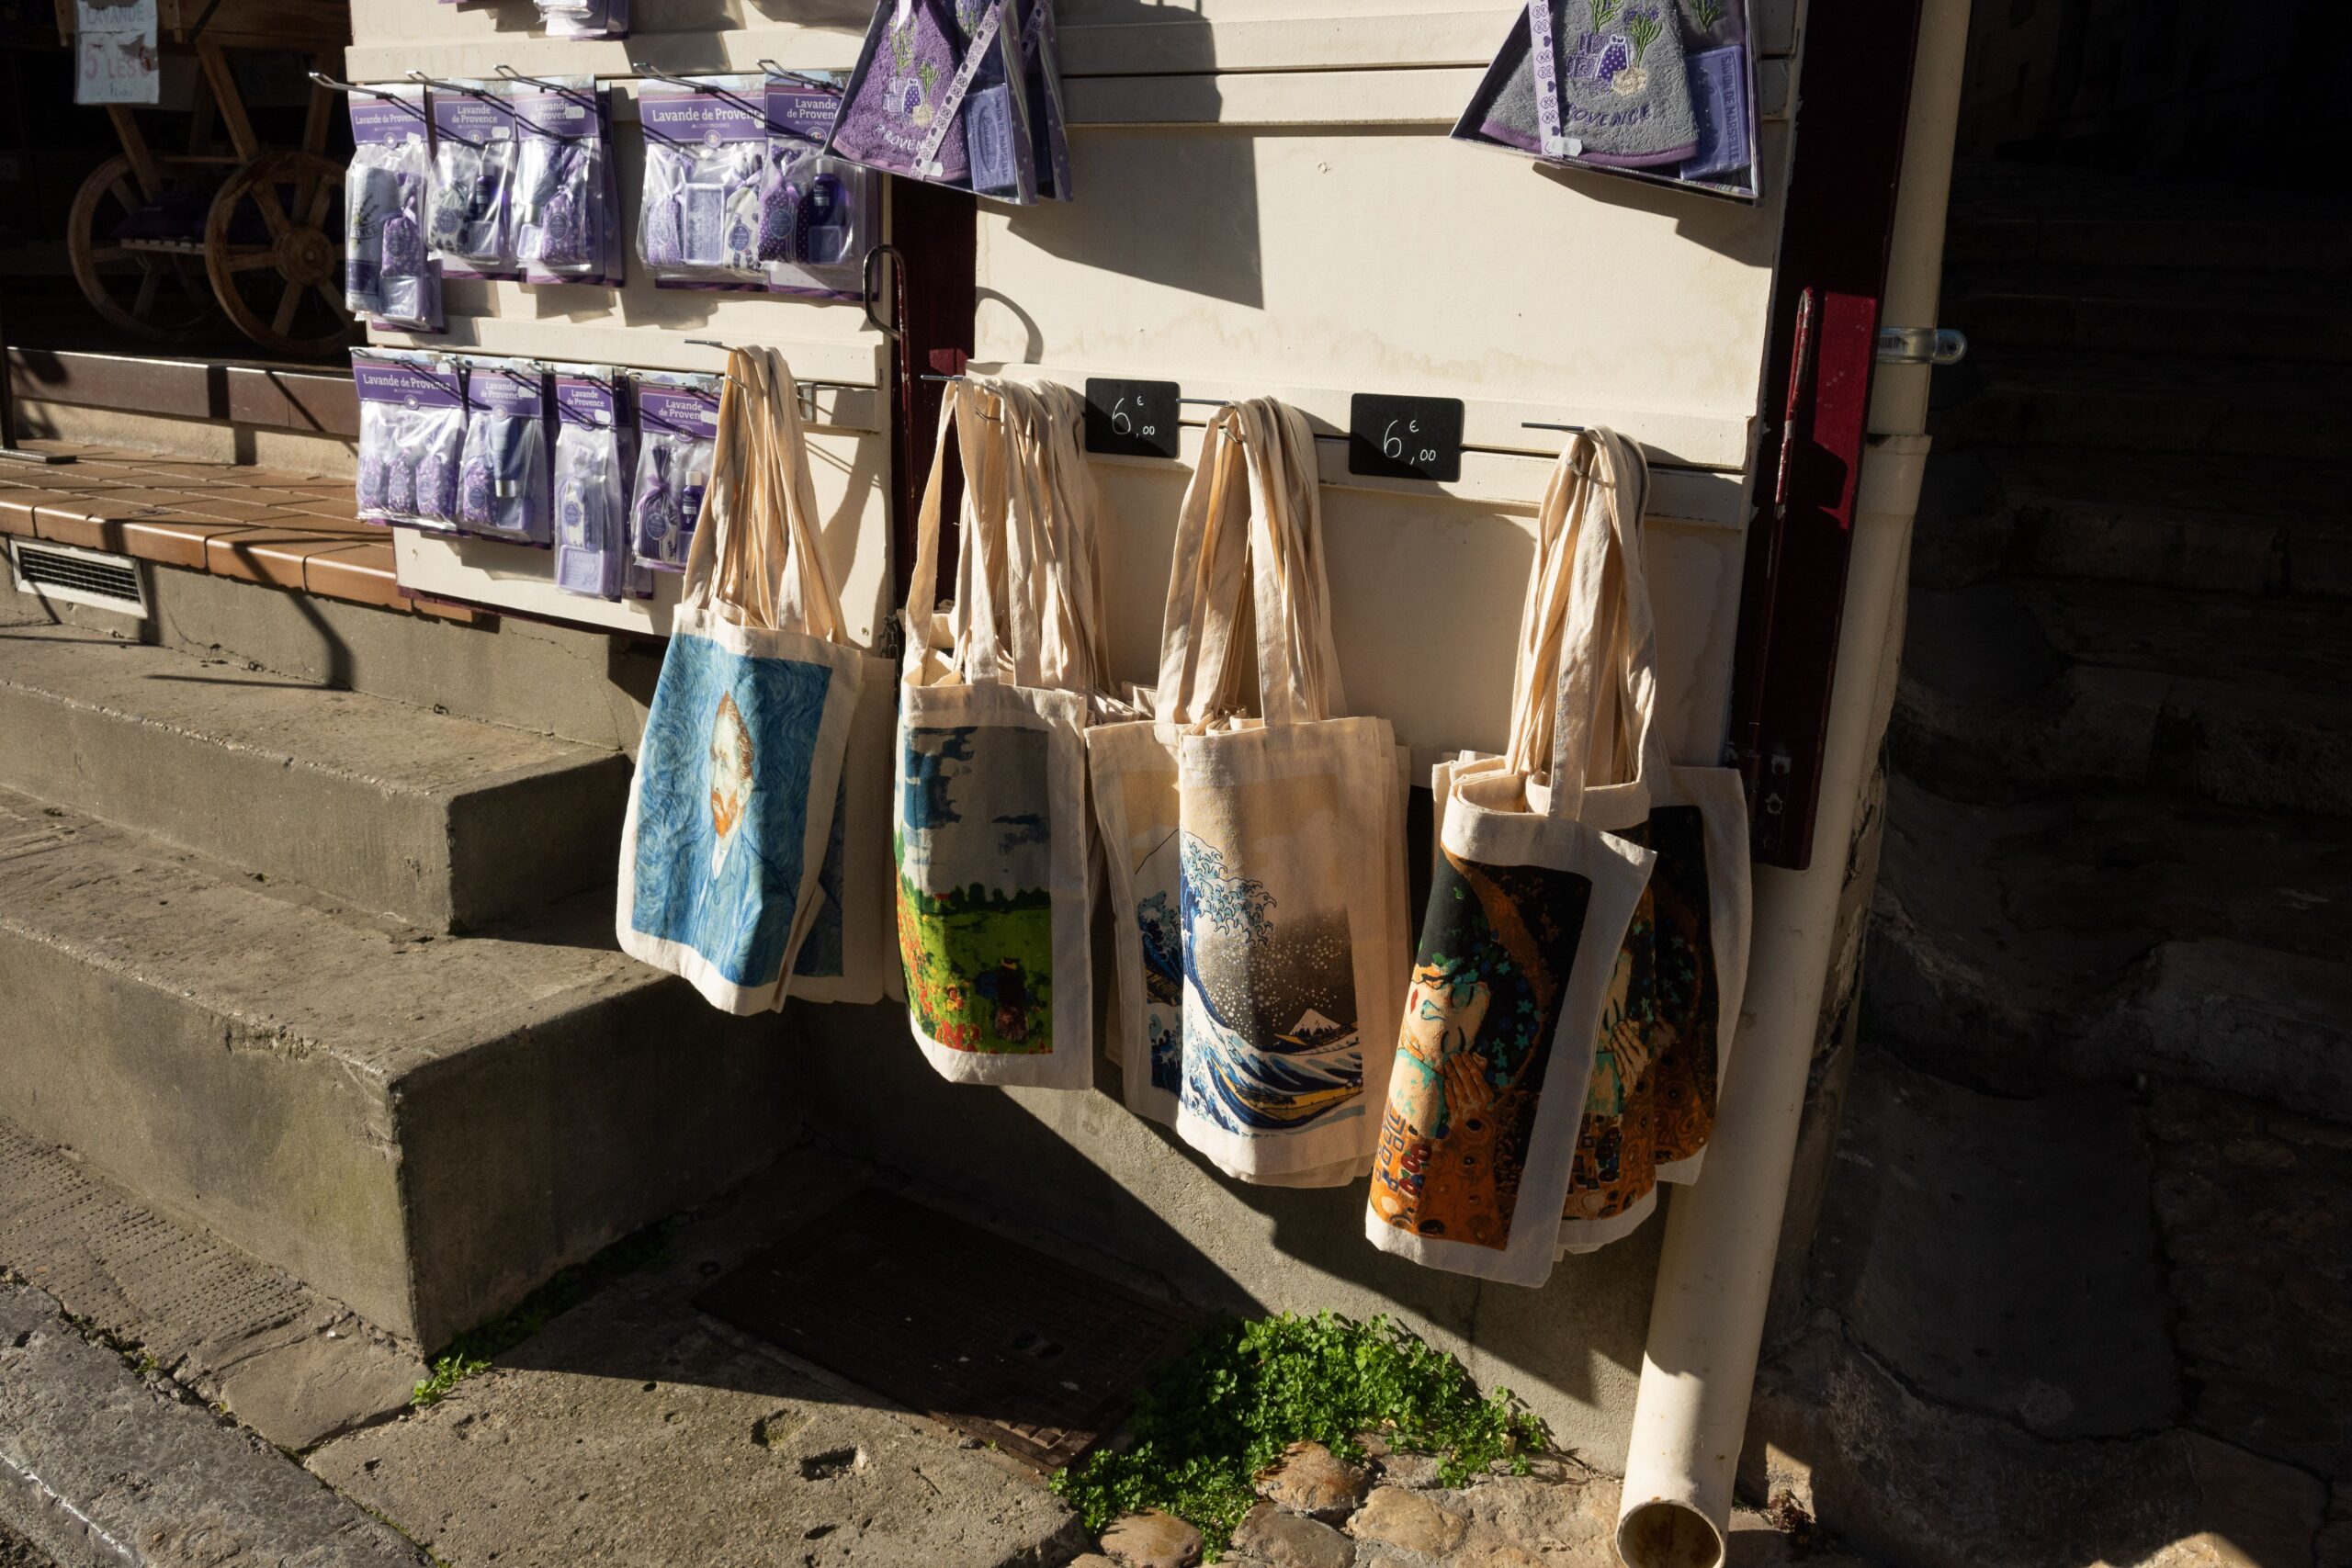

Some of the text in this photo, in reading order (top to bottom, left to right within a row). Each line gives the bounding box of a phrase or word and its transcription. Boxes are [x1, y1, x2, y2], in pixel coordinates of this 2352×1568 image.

[457, 104, 491, 115] Lavande
[795, 98, 837, 109] Lavande
[1721, 56, 1740, 161] SAVON DE MARSEILLE
[355, 113, 382, 125] Lavande
[382, 115, 390, 123] de
[451, 114, 498, 123] de Provence
[652, 107, 699, 122] Lavande
[701, 108, 714, 120] de
[786, 107, 836, 119] de Proven
[1568, 102, 1651, 127] ROVENCE
[875, 122, 926, 152] PROVEN
[363, 374, 400, 387] Lavande
[401, 378, 410, 388] de
[485, 380, 517, 390] Lavande
[480, 389, 487, 398] de
[571, 389, 599, 399] Lavande
[566, 397, 605, 408] de Provence
[665, 399, 703, 412] Lavande
[658, 407, 702, 420] de Proven
